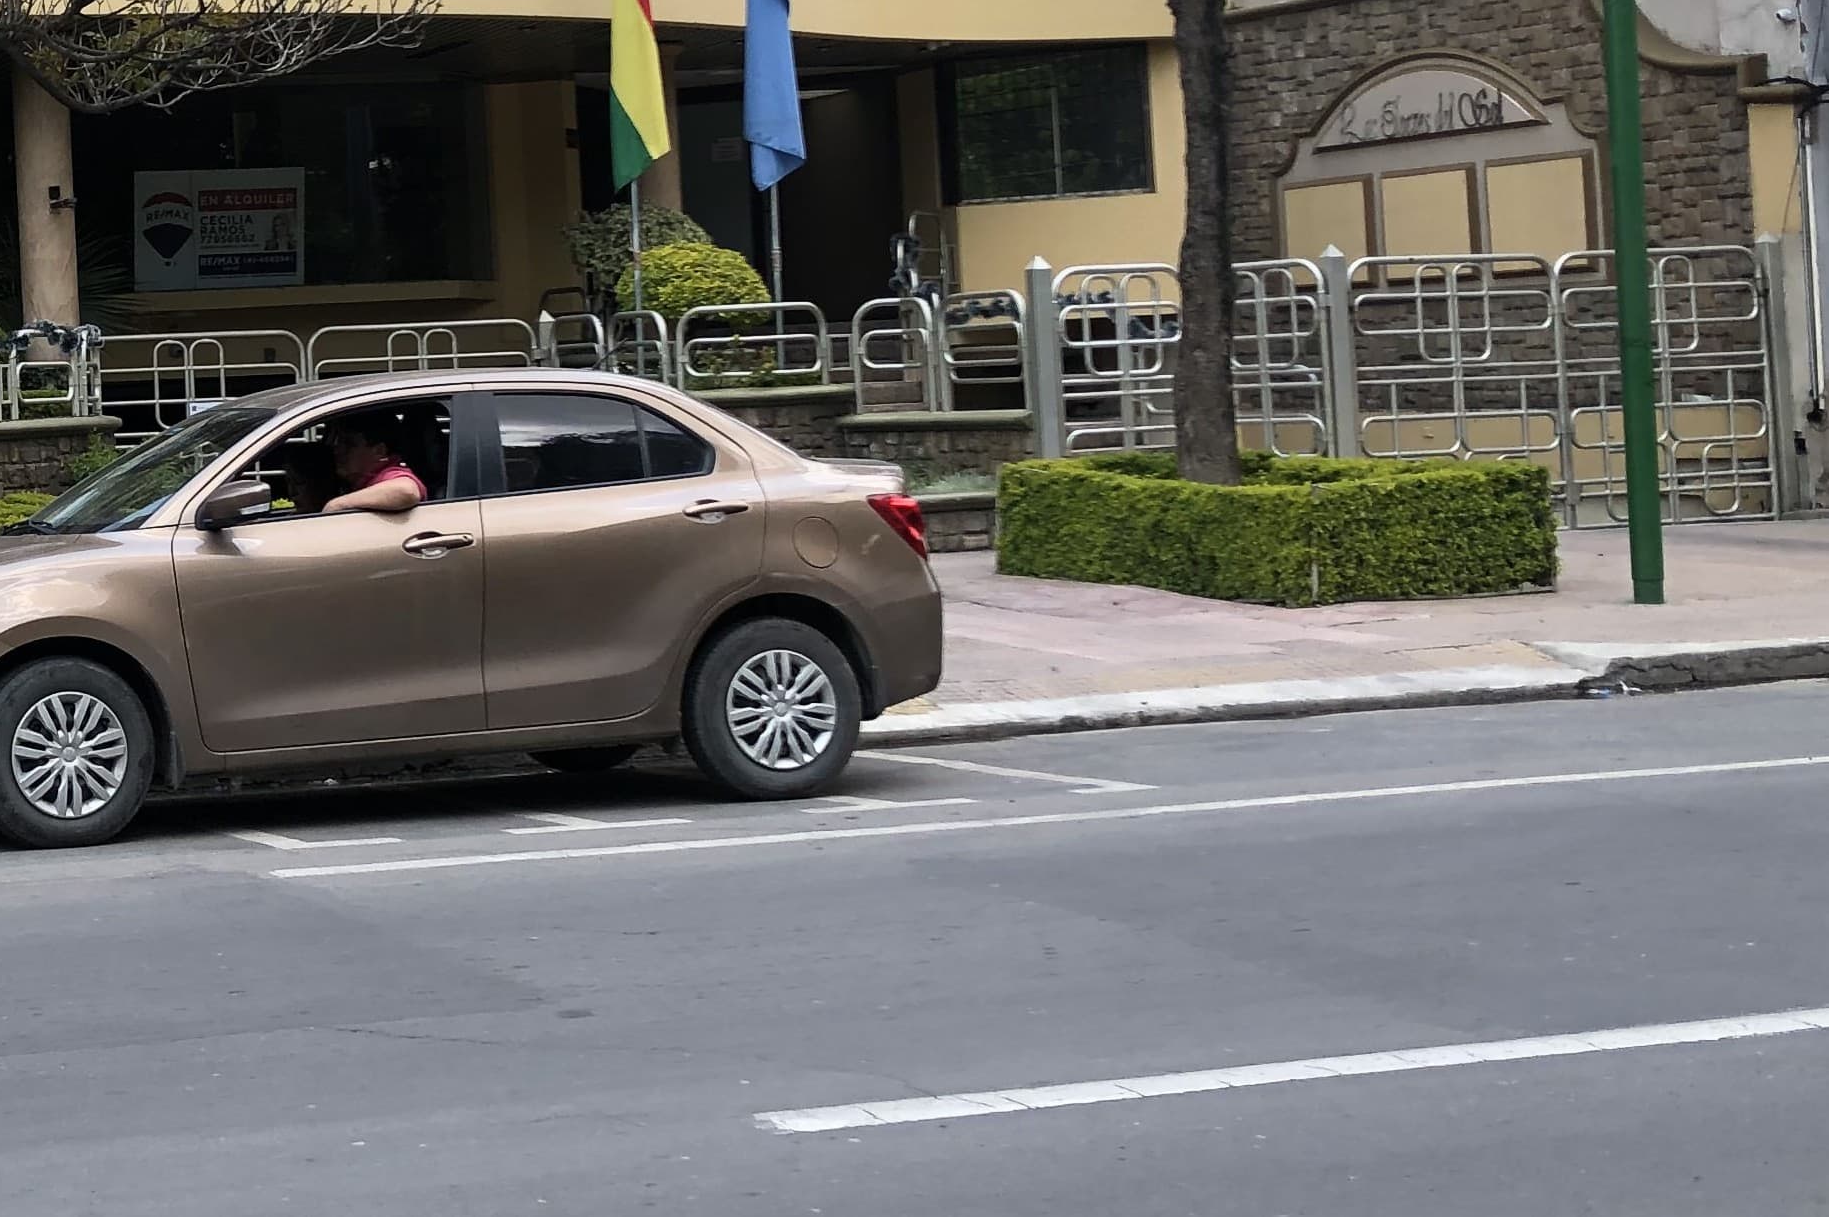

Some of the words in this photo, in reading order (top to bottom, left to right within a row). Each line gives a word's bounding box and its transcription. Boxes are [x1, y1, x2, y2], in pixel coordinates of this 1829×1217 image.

[200, 194, 219, 207] EN
[223, 191, 295, 205] ALQUILER
[146, 209, 189, 223] RE/MAX
[200, 214, 254, 225] CECILIA
[200, 224, 246, 235] RAMOS
[200, 256, 240, 266] RE/MAX
